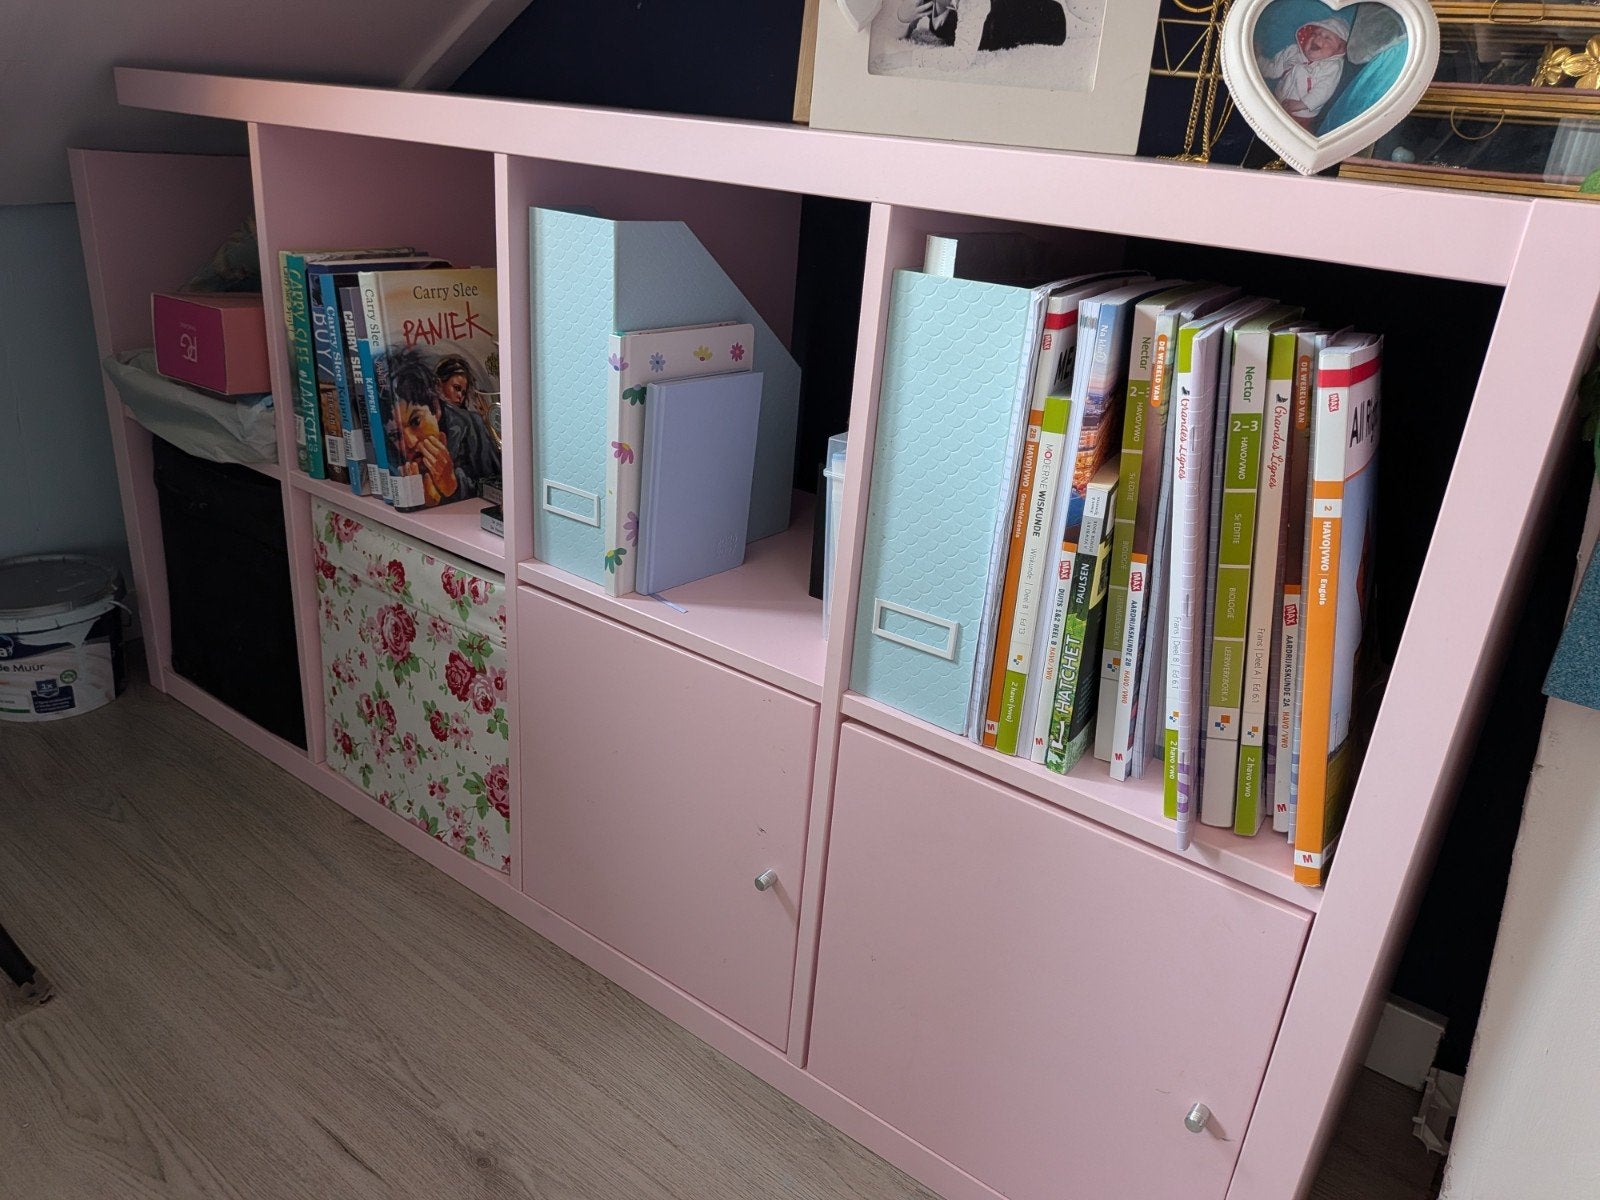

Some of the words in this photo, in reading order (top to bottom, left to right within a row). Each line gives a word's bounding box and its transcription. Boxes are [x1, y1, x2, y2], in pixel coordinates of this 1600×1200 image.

[413, 285, 449, 301] Carry
[453, 282, 479, 298] Slee
[364, 289, 375, 321] Carry
[369, 323, 380, 347] Slee
[403, 301, 494, 352] PANIEK
[326, 306, 338, 348] Carry
[333, 352, 342, 381] Slee
[343, 310, 358, 352] CARRY
[351, 356, 364, 384] SLEE
[1140, 336, 1151, 370] Nectar
[1158, 341, 1165, 351] DE
[1155, 352, 1164, 383] WERELD
[1301, 361, 1308, 372] DE
[366, 377, 378, 414] KAPPEN!
[1243, 366, 1255, 403] Nectar
[1299, 374, 1307, 406] WERELD
[1328, 393, 1339, 412] MAX
[1179, 398, 1190, 444] Grandes
[1297, 408, 1305, 424] VAN
[1272, 405, 1288, 452] Grandes
[1176, 445, 1187, 480] Lignes
[1267, 453, 1284, 490] Lignes
[1032, 490, 1047, 538] WISKUNDE
[1233, 522, 1242, 545] EDITIE
[1060, 560, 1071, 580] MAX
[1076, 563, 1090, 604] PAULSEN
[1131, 572, 1142, 592] MAX
[1318, 578, 1328, 606] Engels
[1056, 588, 1065, 607] DUITS
[1227, 587, 1236, 619] BIOLOGIE
[1172, 616, 1181, 635] Frans
[1284, 603, 1297, 626] MAX
[1052, 623, 1060, 639] DEEL
[1125, 600, 1138, 656] AARDRIJKSKUNDE
[1257, 628, 1266, 647] Frans
[1171, 640, 1180, 656] Deel
[13, 664, 45, 672] Muur
[1255, 652, 1263, 668] Deel
[1283, 635, 1294, 697] AARDRIJKSKUNDE
[1056, 634, 1081, 714] HATCHET
[1172, 670, 1179, 680] Ed
[1009, 687, 1018, 702] havo
[1252, 683, 1260, 692] Ed
[1283, 698, 1290, 708] 2A
[1169, 747, 1177, 763] havo
[1245, 763, 1255, 781] havo
